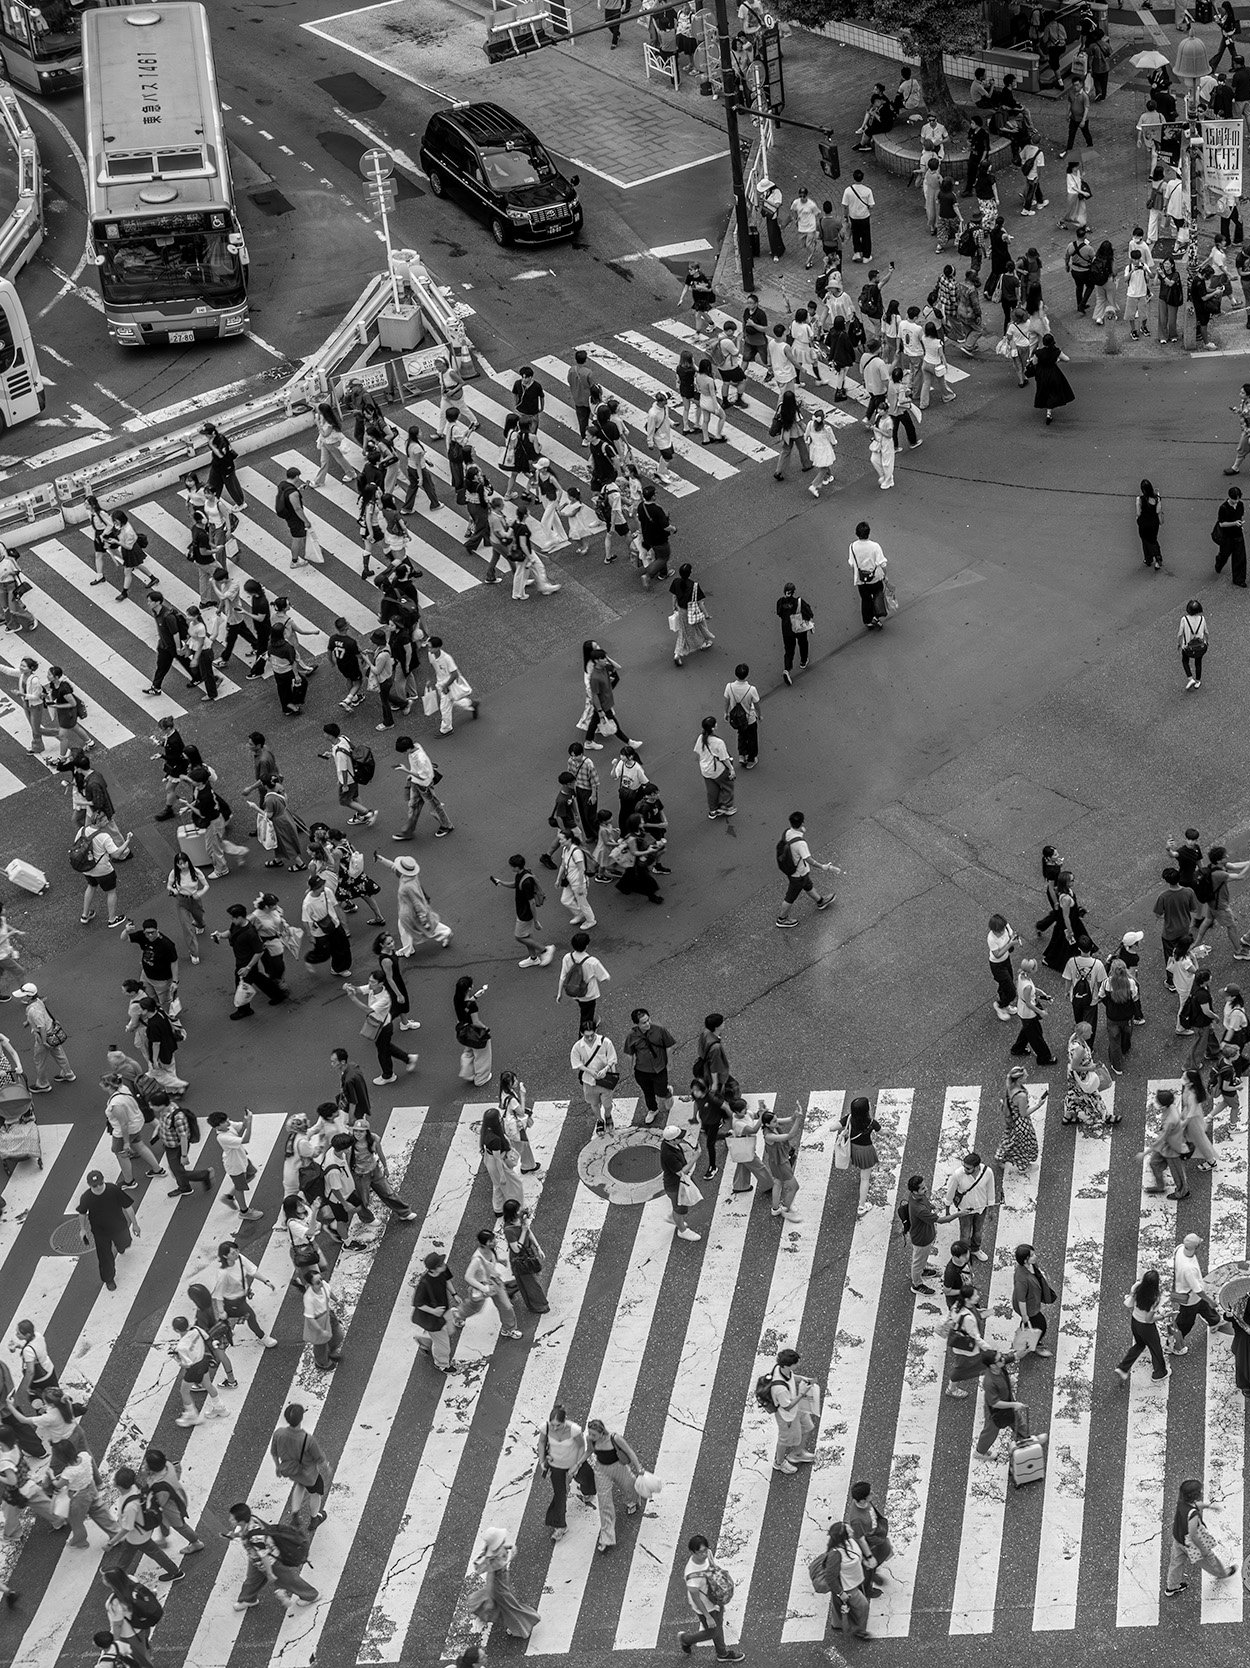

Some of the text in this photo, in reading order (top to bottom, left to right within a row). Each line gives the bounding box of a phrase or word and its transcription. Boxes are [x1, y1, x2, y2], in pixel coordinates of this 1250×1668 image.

[136, 52, 162, 125] 東急バス 1461
